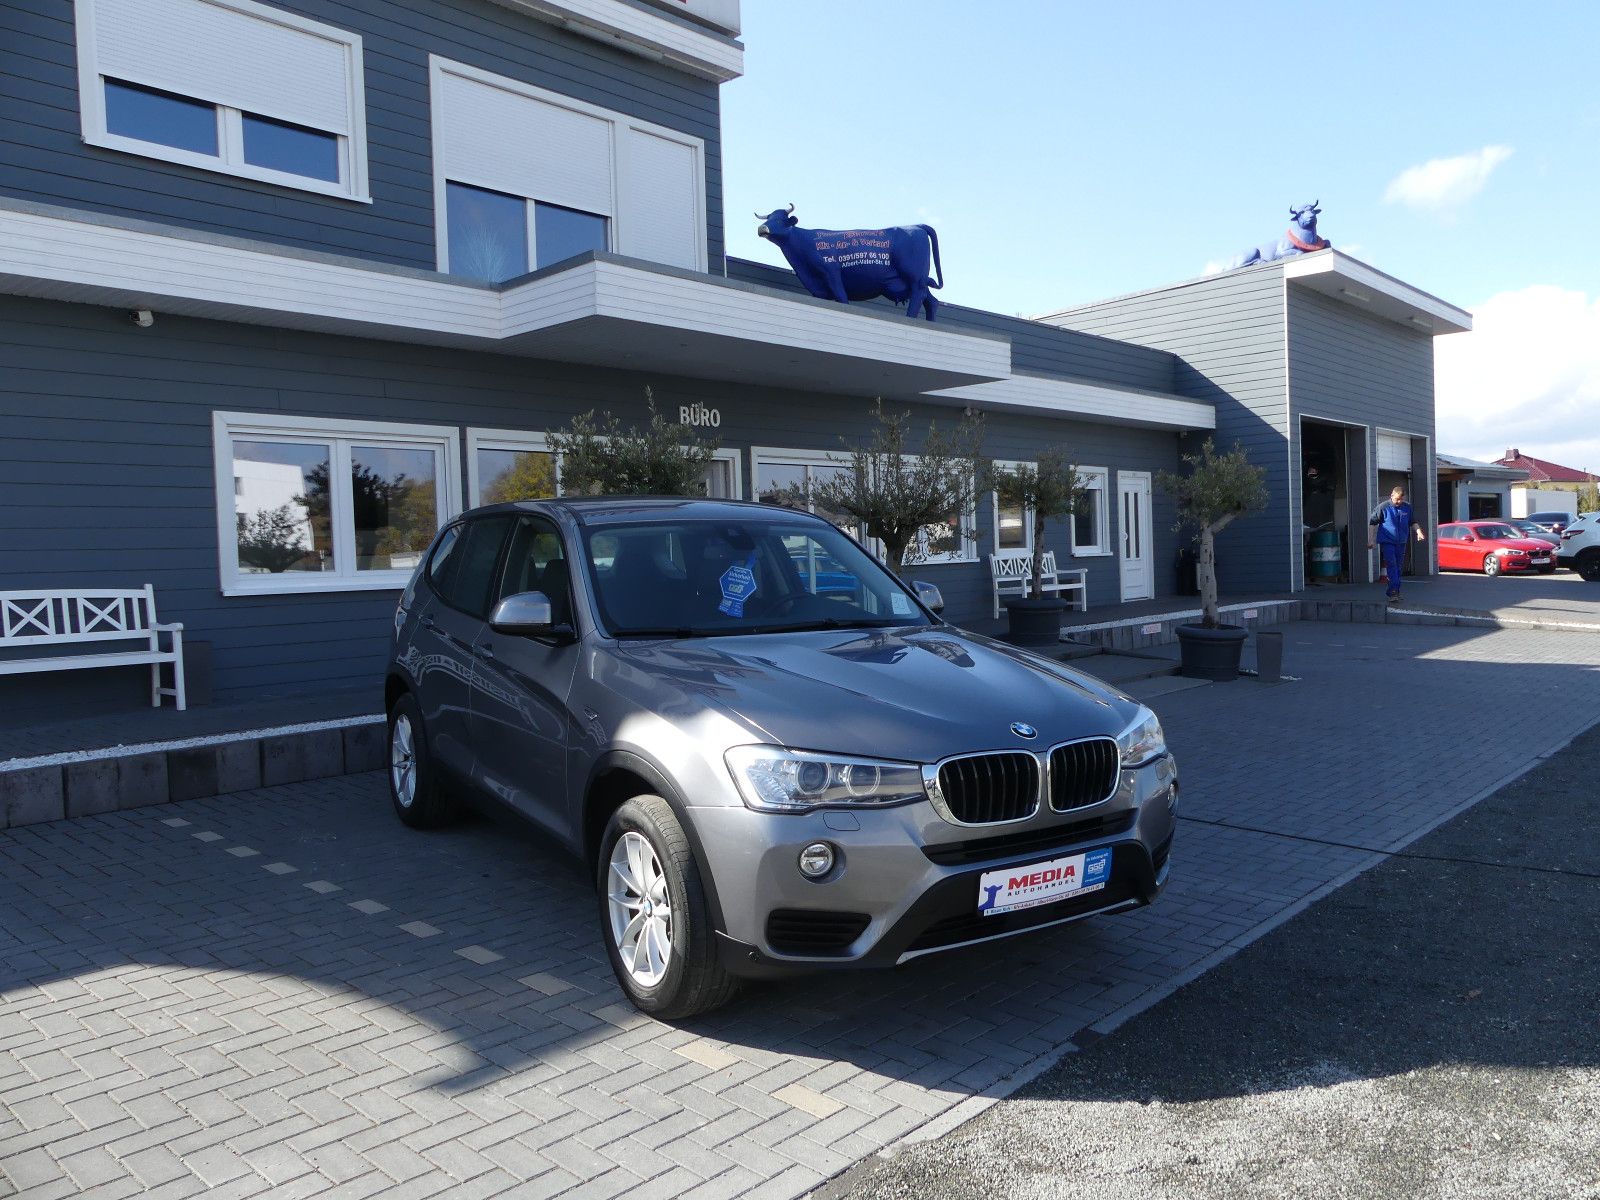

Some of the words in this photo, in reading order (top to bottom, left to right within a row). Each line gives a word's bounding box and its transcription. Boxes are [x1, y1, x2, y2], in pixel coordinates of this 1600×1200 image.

[823, 256, 836, 264] Tel.
[839, 252, 867, 262] 0391/597
[879, 252, 890, 260] 100
[680, 403, 721, 427] BÜRO
[1007, 878, 1076, 897] AUTOHANDEL
[1008, 865, 1075, 890] MEDIA
